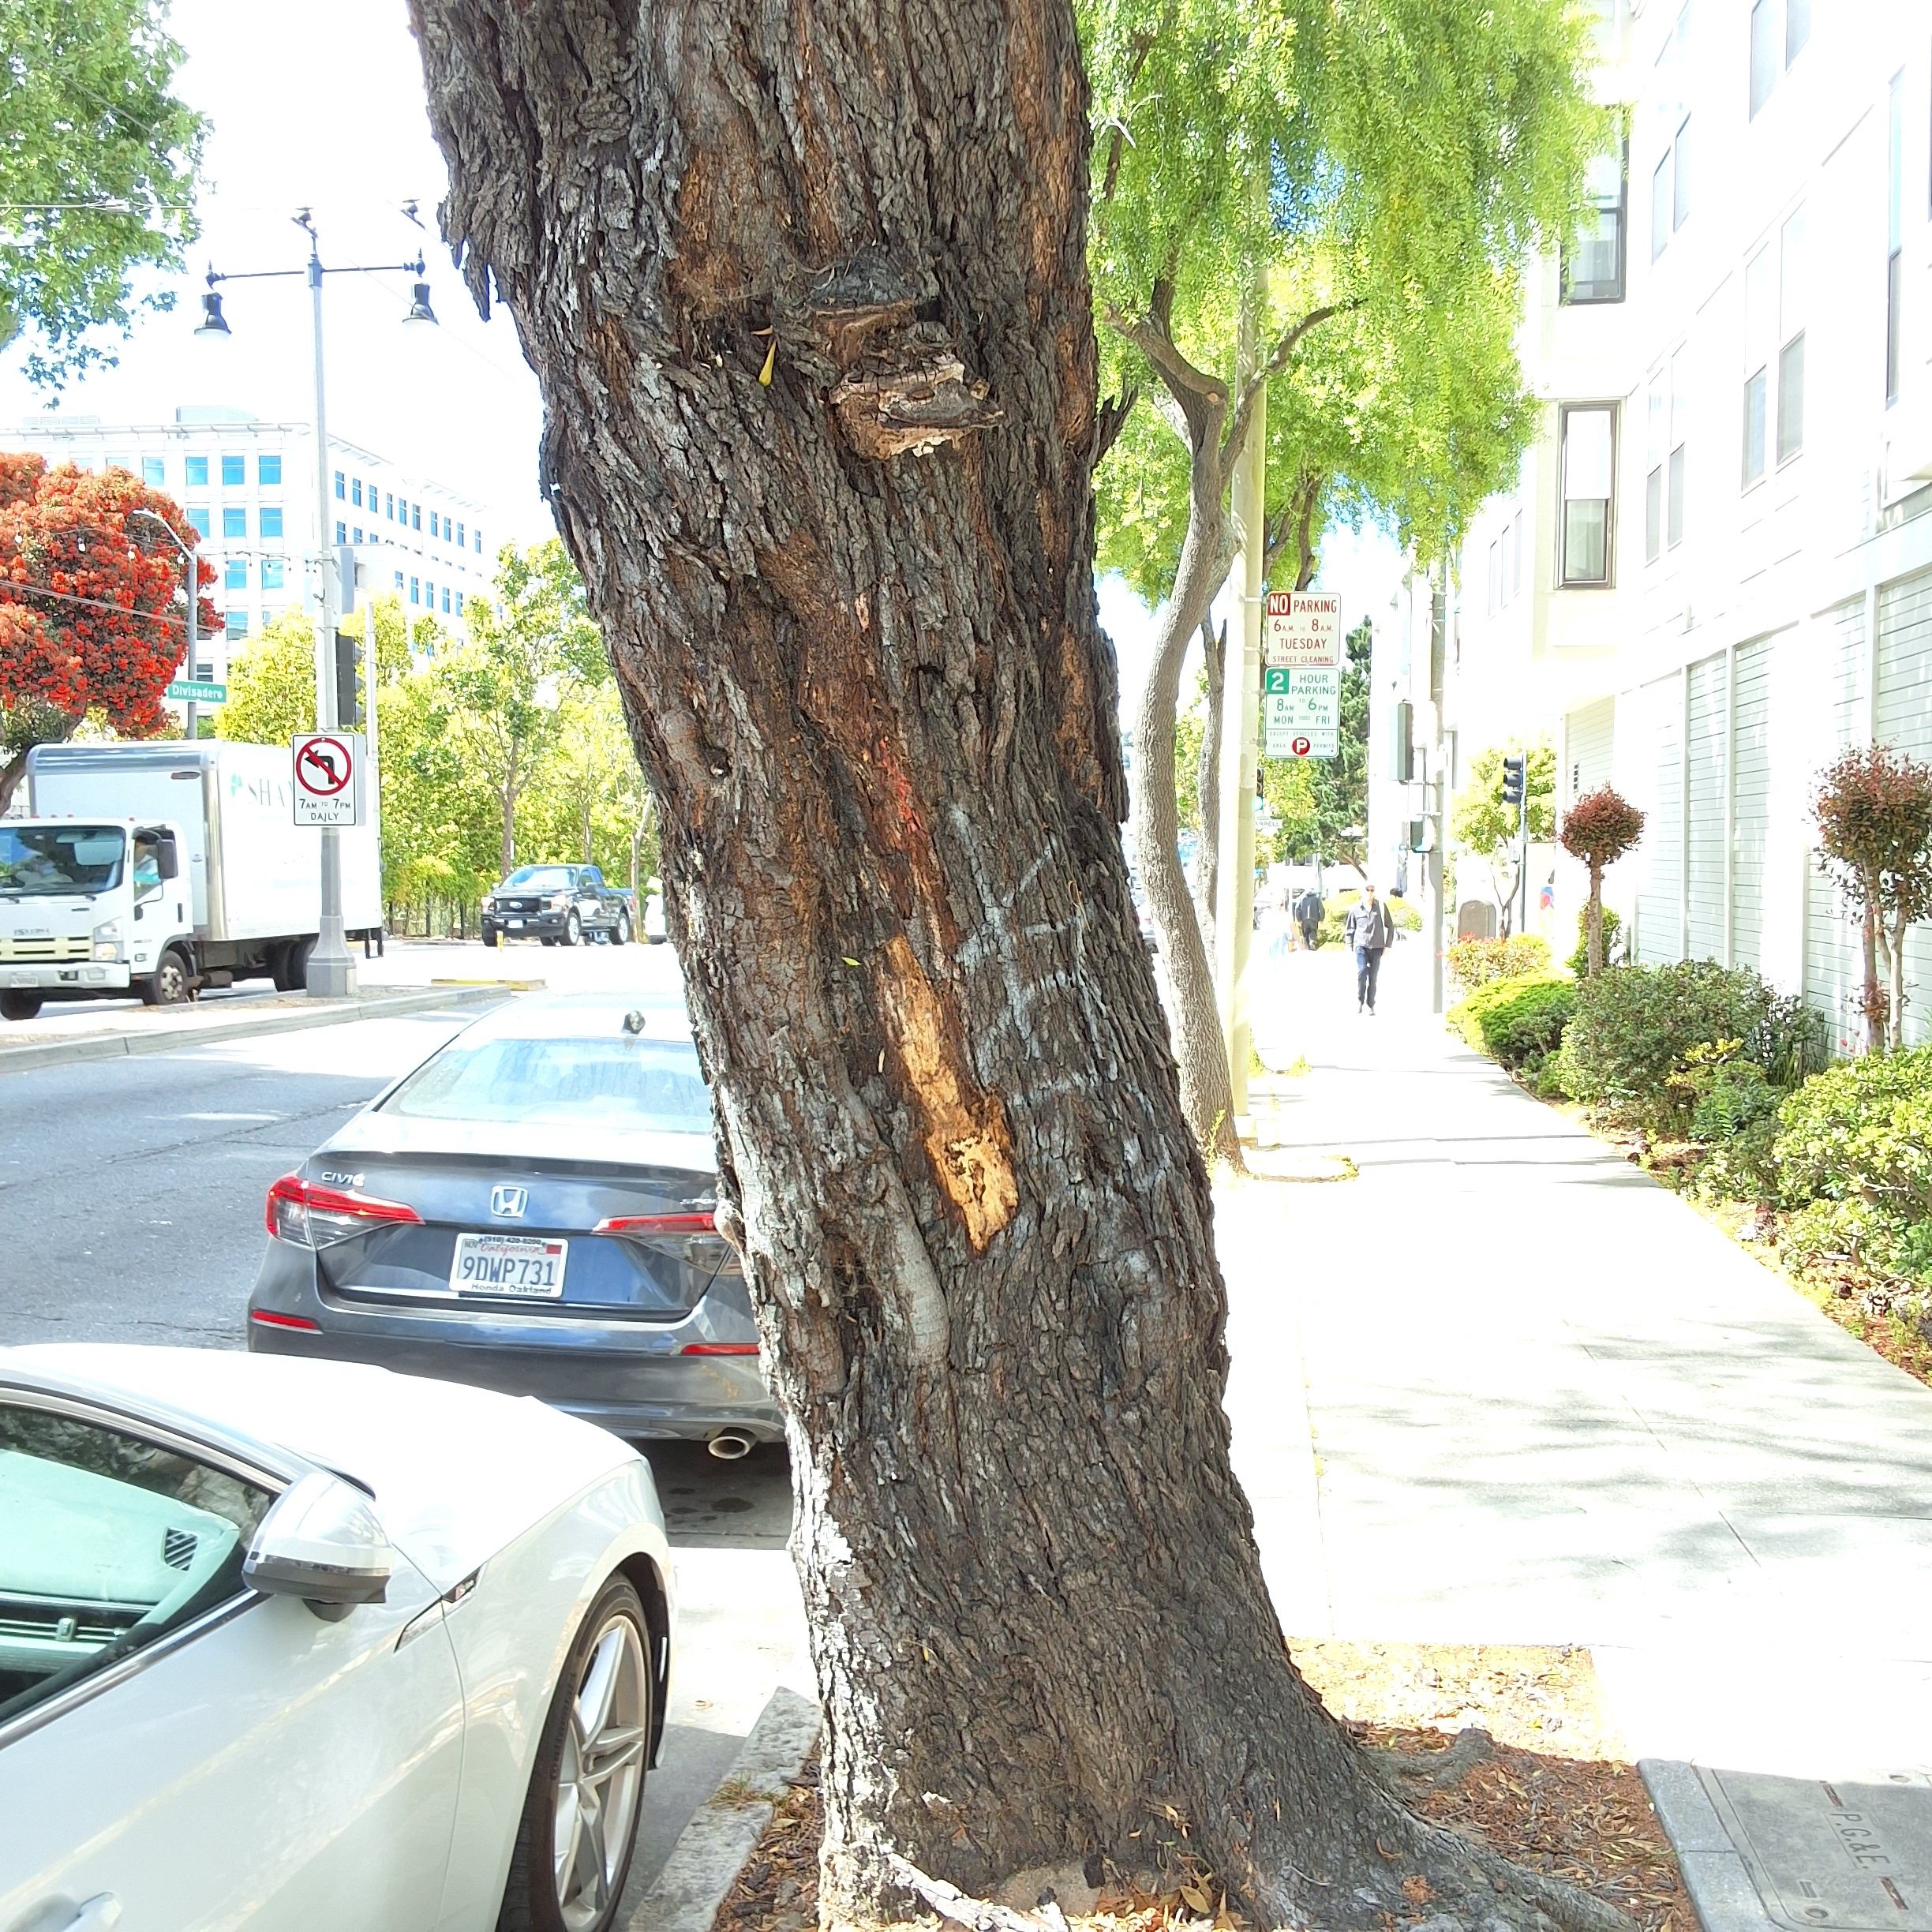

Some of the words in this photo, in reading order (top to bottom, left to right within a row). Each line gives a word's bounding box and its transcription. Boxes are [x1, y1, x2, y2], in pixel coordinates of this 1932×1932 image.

[1269, 593, 1289, 614] NO
[1294, 599, 1338, 613] PARKING
[1279, 638, 1327, 650] TUESDAY
[1271, 672, 1285, 691] 2
[1300, 674, 1328, 683] HOUR
[171, 684, 223, 699] Divisadero
[1291, 686, 1336, 695] PARKING
[1274, 715, 1294, 724] MON
[1316, 715, 1330, 724] FRI
[310, 812, 339, 822] DAILY
[321, 1171, 365, 1187] CIVIC
[462, 1256, 555, 1286] 9DWP731
[471, 1283, 504, 1292] Honda
[509, 1285, 552, 1295] Oakland
